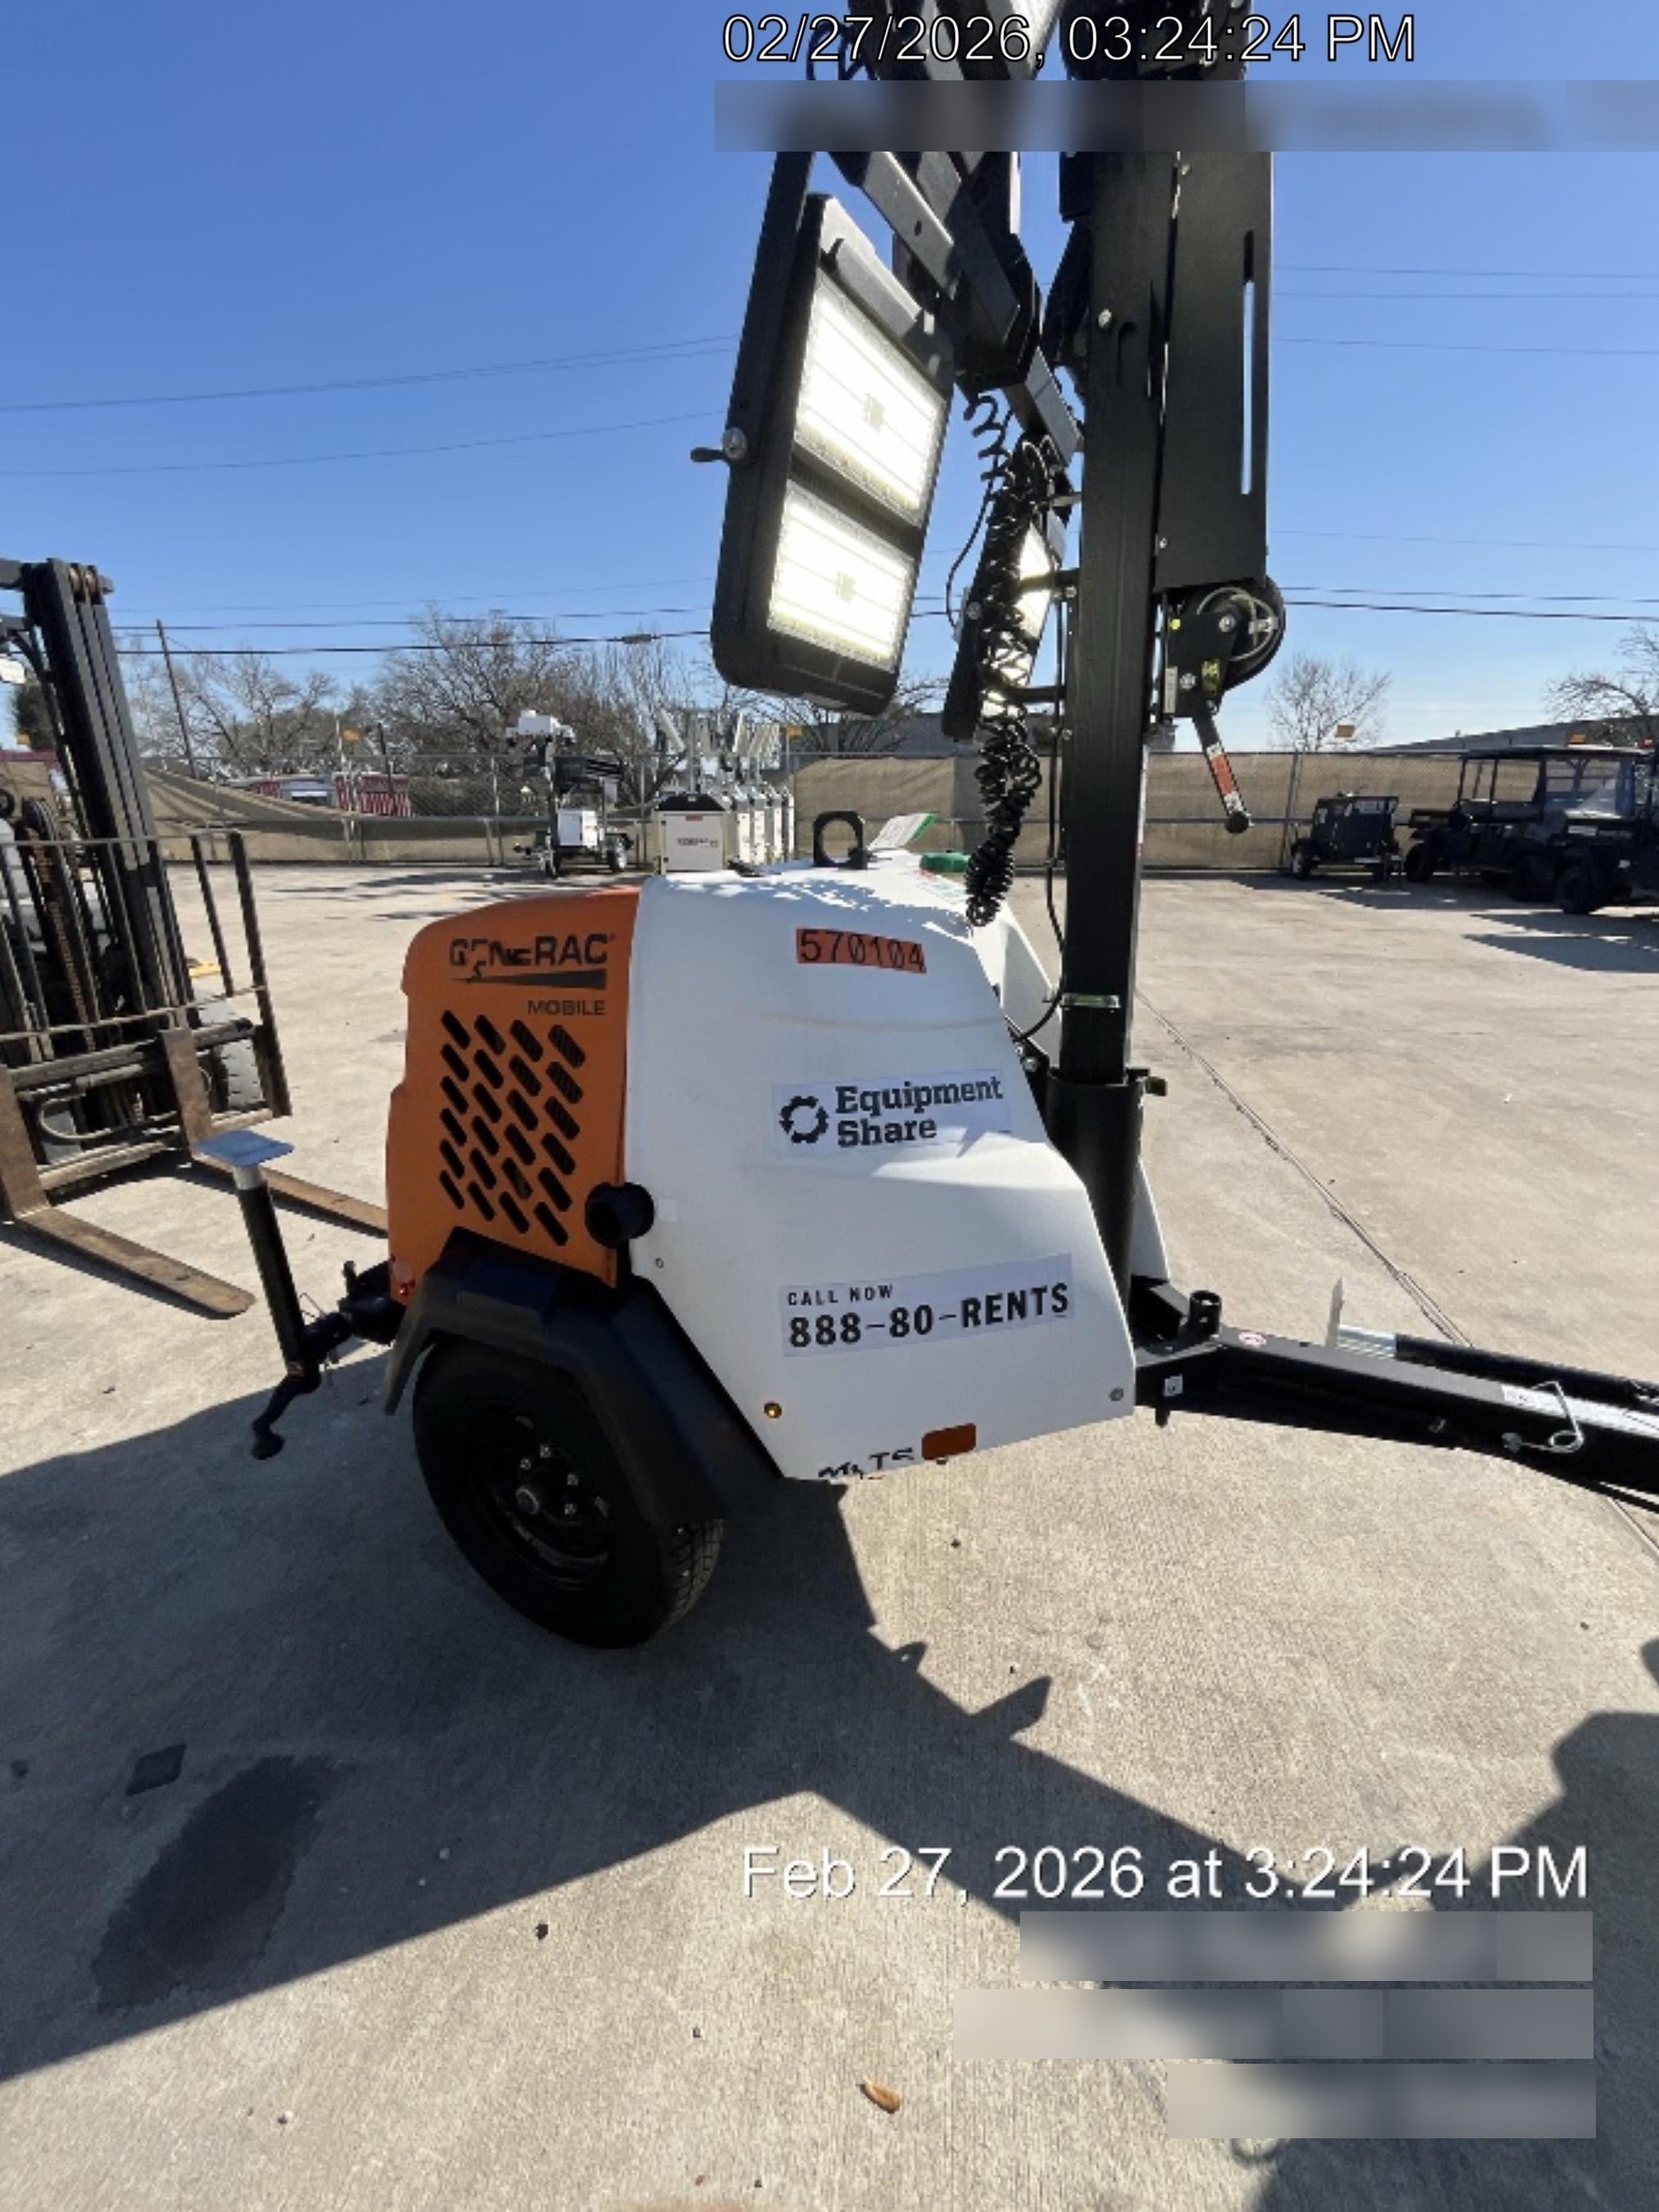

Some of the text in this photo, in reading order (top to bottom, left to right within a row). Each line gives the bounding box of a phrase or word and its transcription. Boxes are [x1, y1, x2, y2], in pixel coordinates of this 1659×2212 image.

[800, 929, 925, 972] 570104
[527, 999, 606, 1016] MOBILE
[835, 1077, 1004, 1117] Equipment
[837, 1119, 937, 1147] Share
[787, 1284, 894, 1307] CALL NOW
[790, 1282, 1069, 1348] 888-80-RENTS
